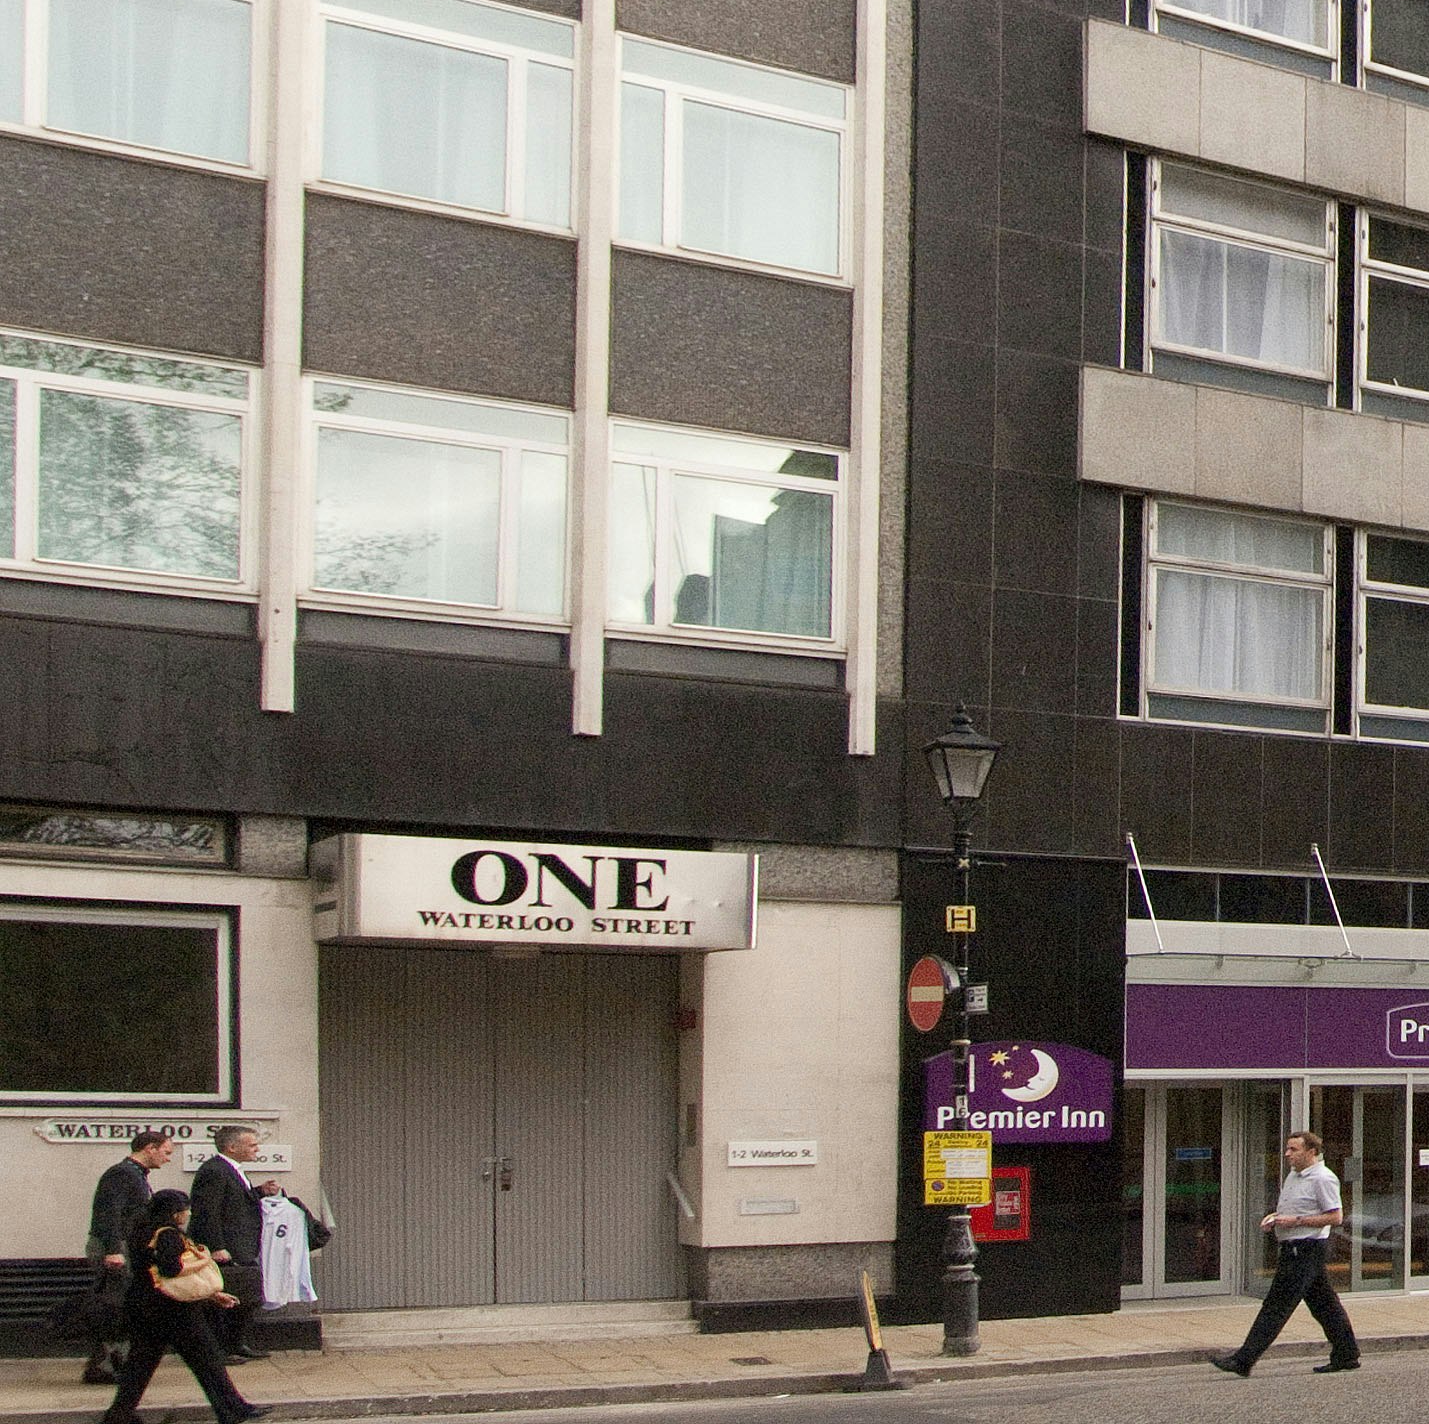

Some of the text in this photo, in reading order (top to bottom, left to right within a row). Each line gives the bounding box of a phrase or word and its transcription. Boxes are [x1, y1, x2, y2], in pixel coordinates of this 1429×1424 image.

[450, 849, 671, 912] ONE
[417, 909, 697, 936] WATERLOO STREET
[951, 908, 971, 929] H
[1061, 1105, 1106, 1129] Inn
[934, 1132, 983, 1140] WARNING
[272, 1153, 288, 1164] St.
[732, 1150, 746, 1159] 1-2
[750, 1149, 798, 1159] Waterloo
[275, 1224, 288, 1238] 6
